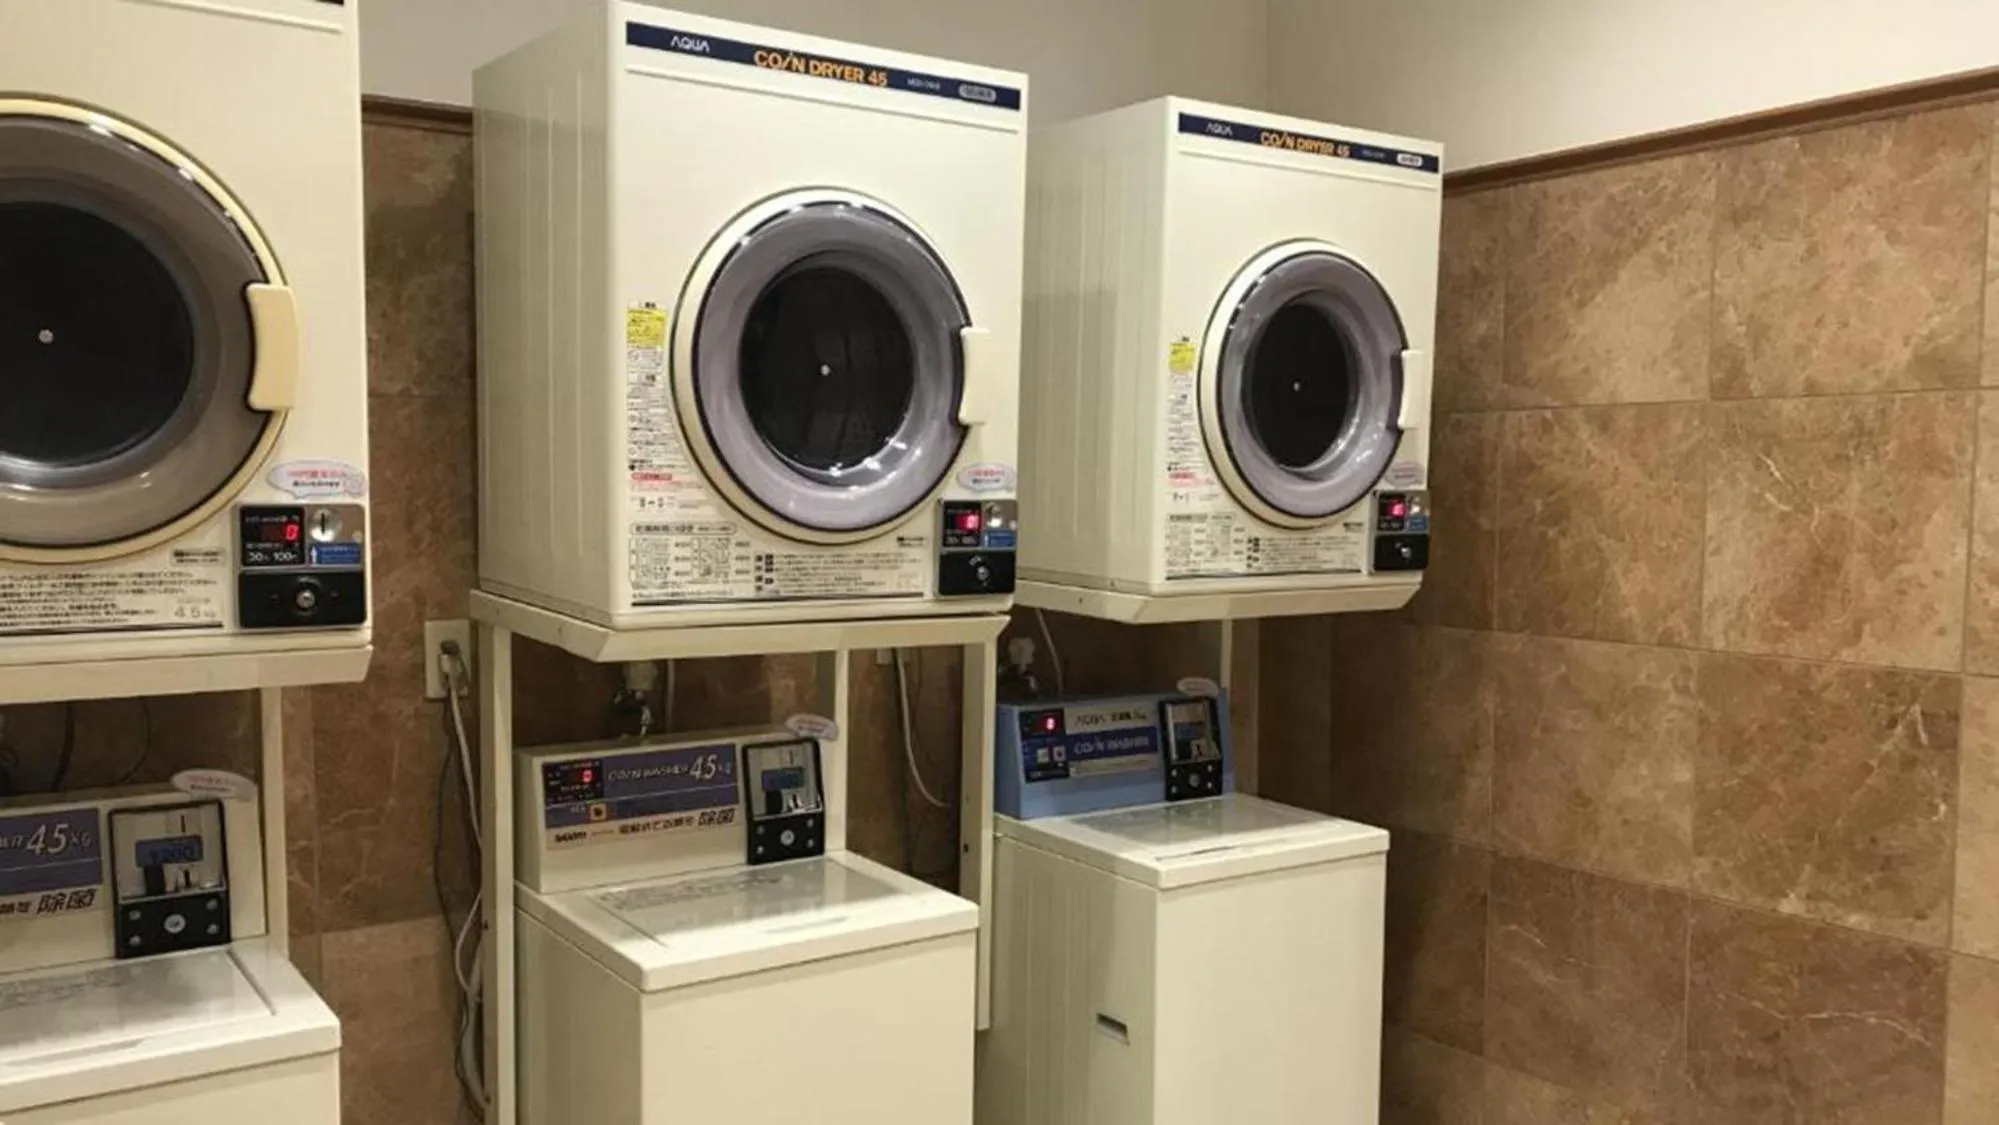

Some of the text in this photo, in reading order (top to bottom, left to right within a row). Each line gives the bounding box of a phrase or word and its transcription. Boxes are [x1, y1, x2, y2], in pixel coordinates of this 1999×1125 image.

[670, 35, 711, 53] AQUA
[809, 60, 865, 83] DRYER
[867, 70, 888, 87] 45
[1205, 121, 1233, 136] AQUA
[1296, 138, 1335, 155] DRYER
[1336, 144, 1351, 158] 45
[689, 754, 718, 780] 45
[26, 823, 69, 857] 45
[37, 888, 98, 914] 除菌
